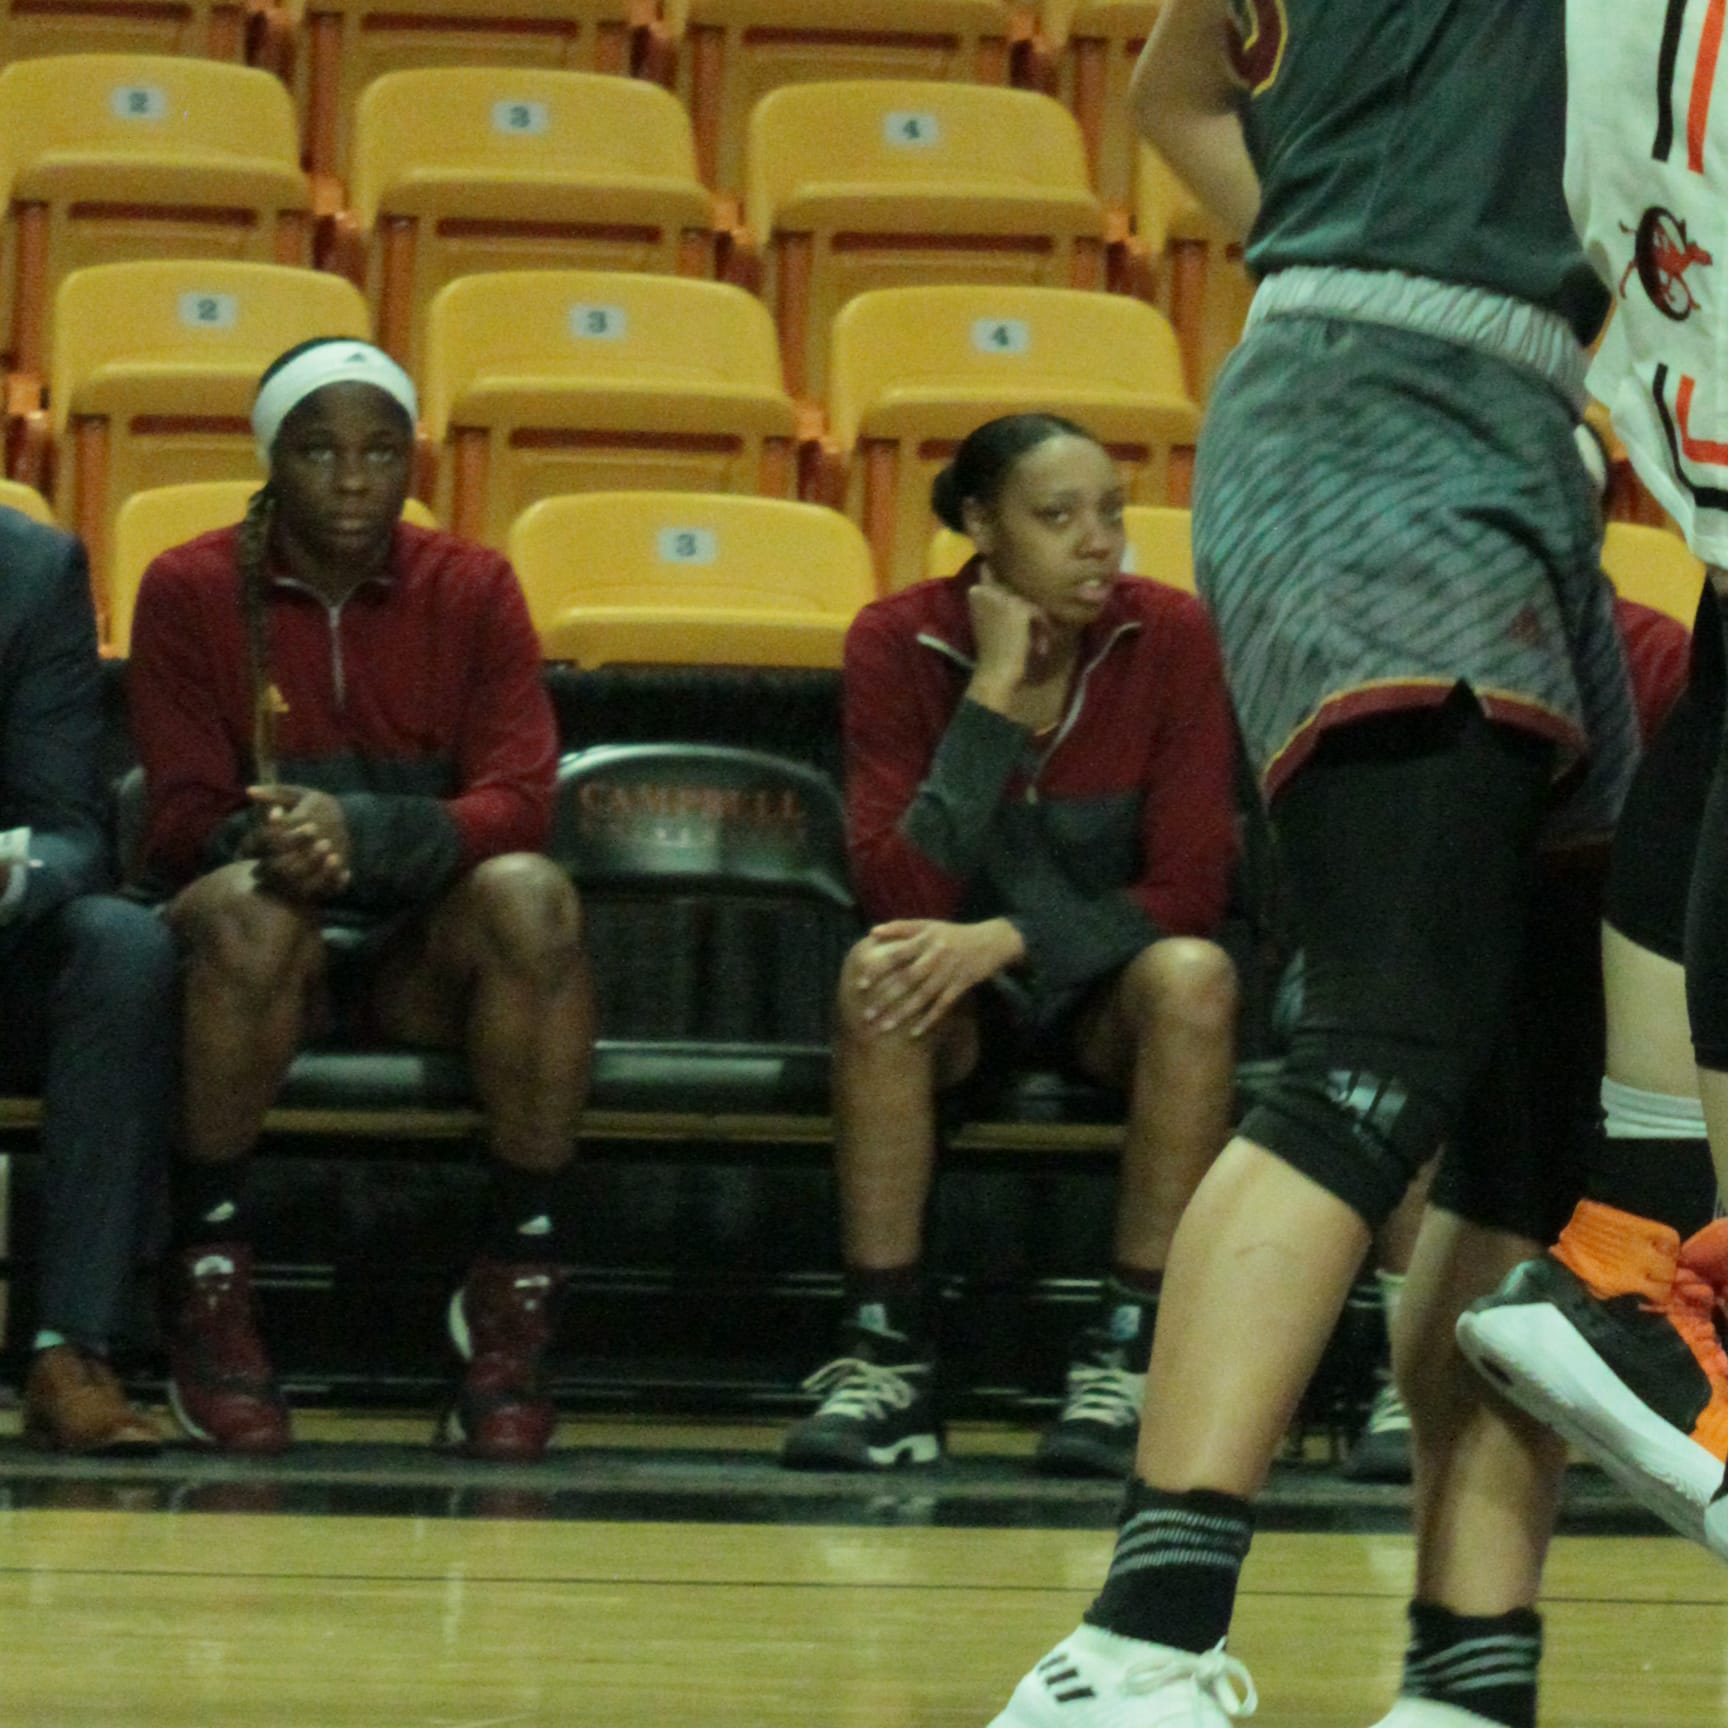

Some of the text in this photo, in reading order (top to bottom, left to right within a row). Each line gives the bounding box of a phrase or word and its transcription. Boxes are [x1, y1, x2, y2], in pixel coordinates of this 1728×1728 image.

[129, 91, 148, 114] 2
[511, 105, 530, 128] 3
[901, 118, 921, 140] 4
[198, 298, 218, 321] 2
[589, 311, 608, 333] 3
[990, 325, 1011, 348] 4
[676, 533, 697, 557] 3
